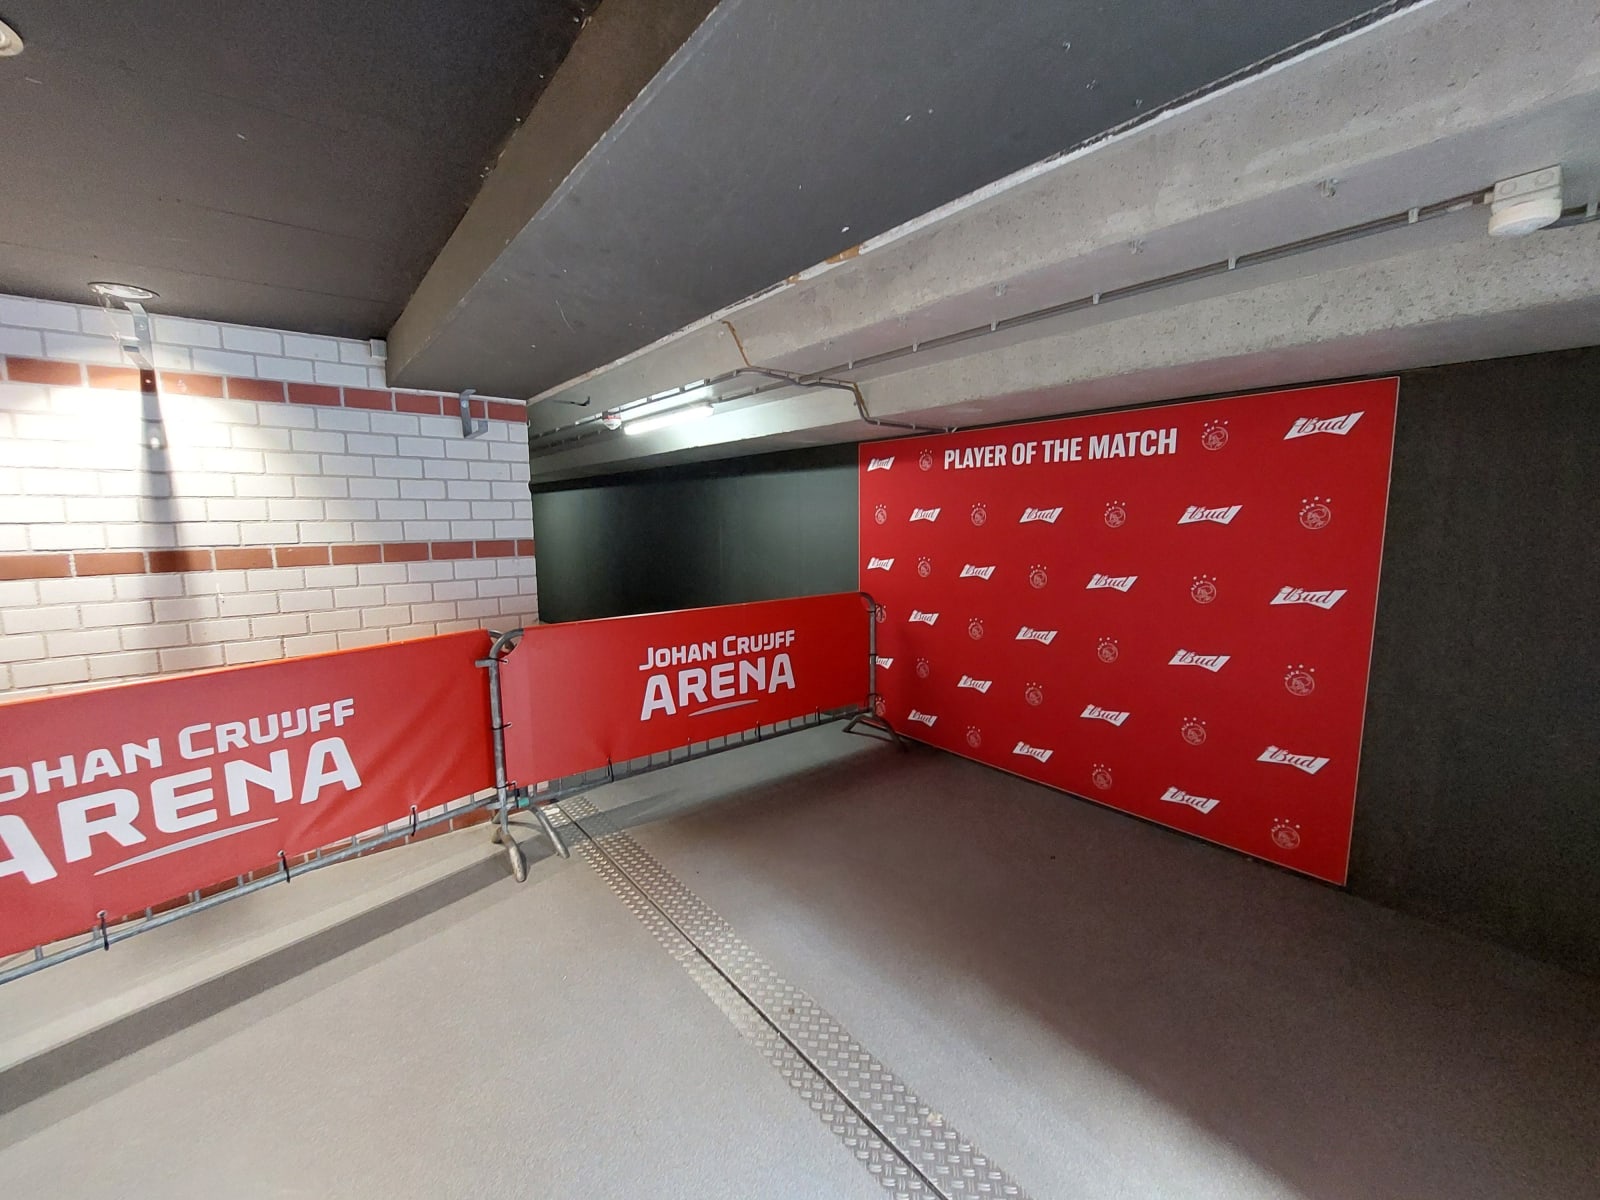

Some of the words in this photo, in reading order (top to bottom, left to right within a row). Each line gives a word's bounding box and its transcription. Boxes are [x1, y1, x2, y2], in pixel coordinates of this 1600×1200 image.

[943, 445, 1007, 470] PLAYER
[1011, 441, 1037, 466] OF
[1042, 437, 1082, 463] THE
[1088, 427, 1178, 460] MATCH
[639, 641, 717, 671] JOHAN
[640, 653, 796, 721] ARENA
[0, 737, 162, 803] OHAN
[0, 736, 362, 885] ARENA
